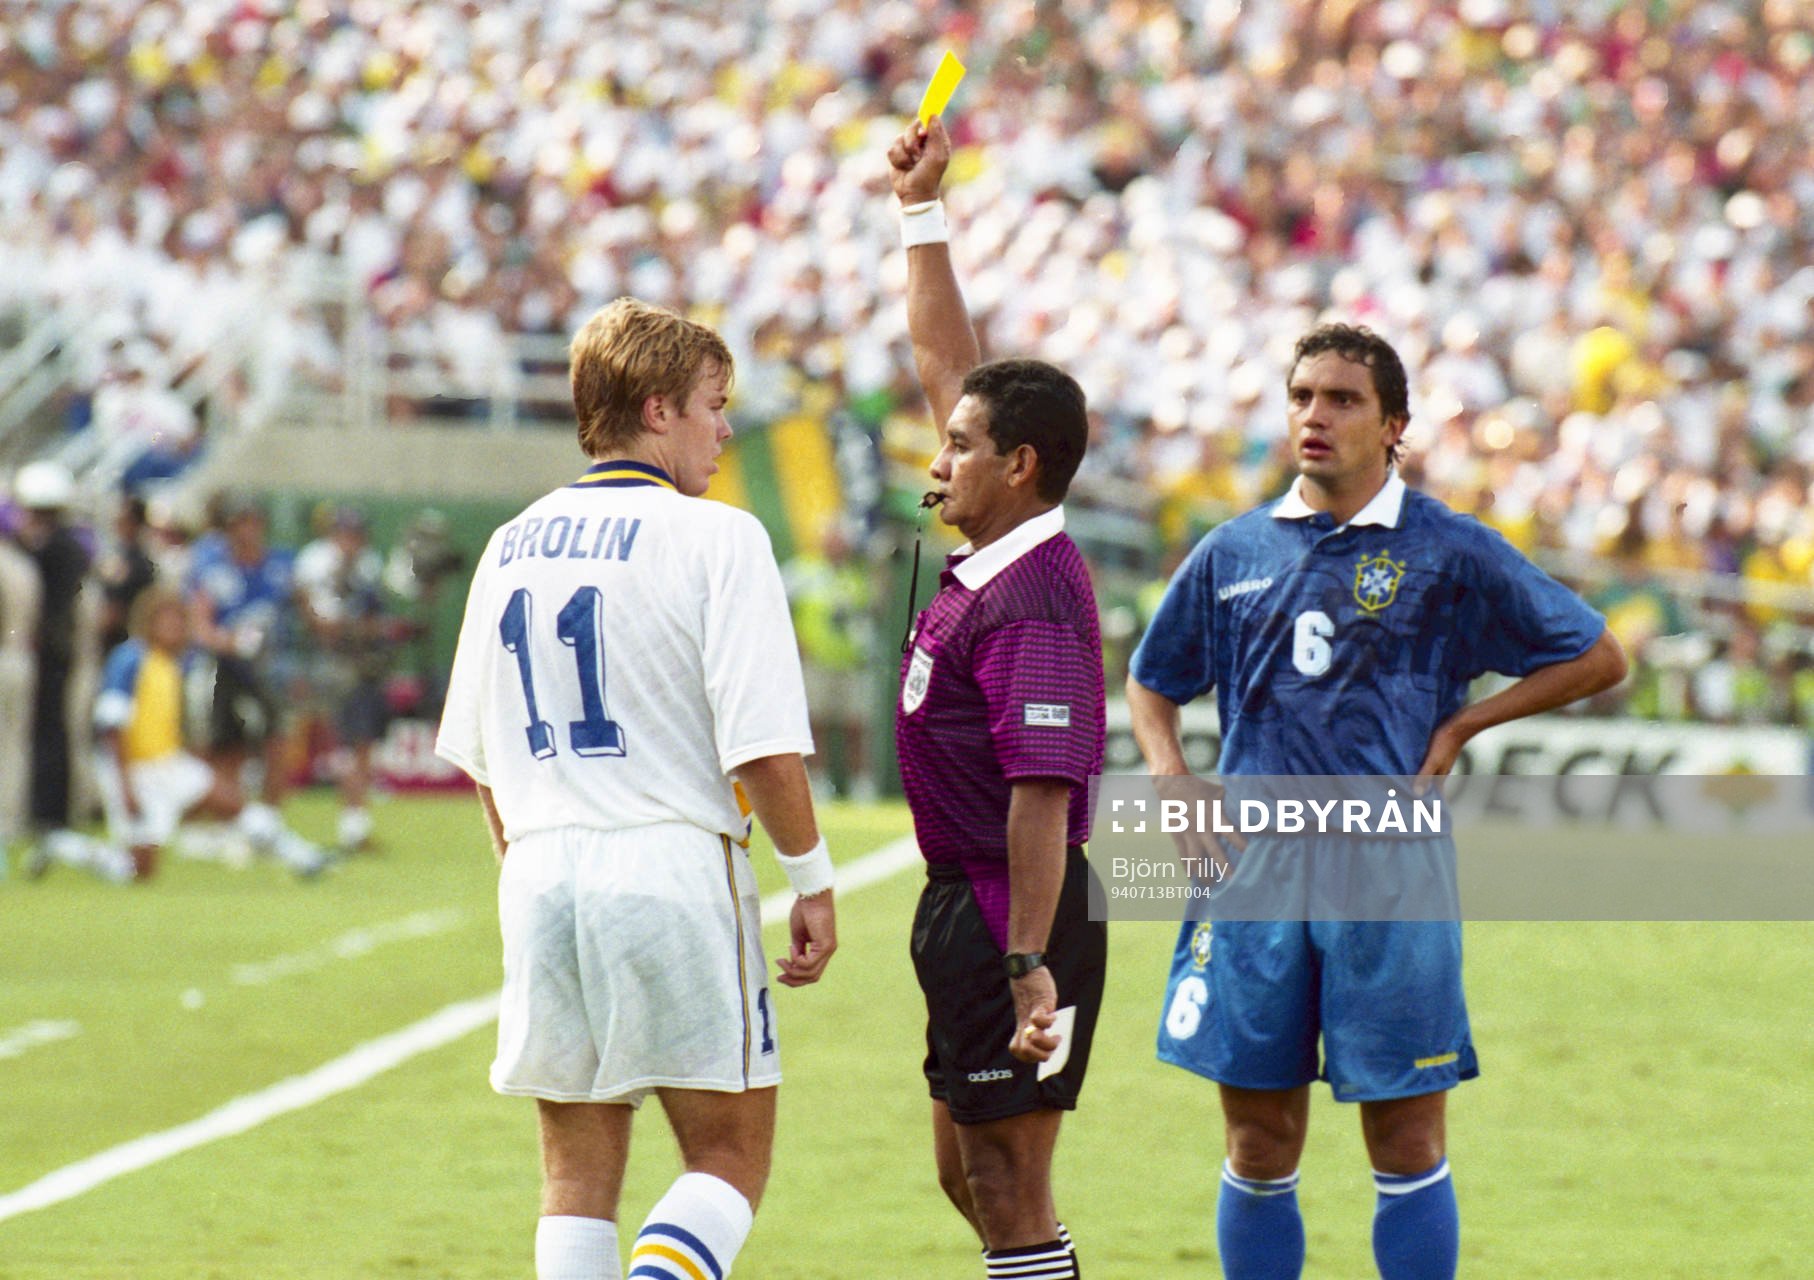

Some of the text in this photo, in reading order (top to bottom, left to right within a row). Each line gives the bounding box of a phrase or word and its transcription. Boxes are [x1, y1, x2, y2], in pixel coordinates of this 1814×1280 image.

[499, 515, 642, 568] BROLIN
[1217, 576, 1274, 601] UMBRO
[499, 585, 627, 761] 11
[1291, 610, 1336, 677] 6
[1165, 975, 1208, 1041] 6
[967, 1068, 1014, 1083] adidas
